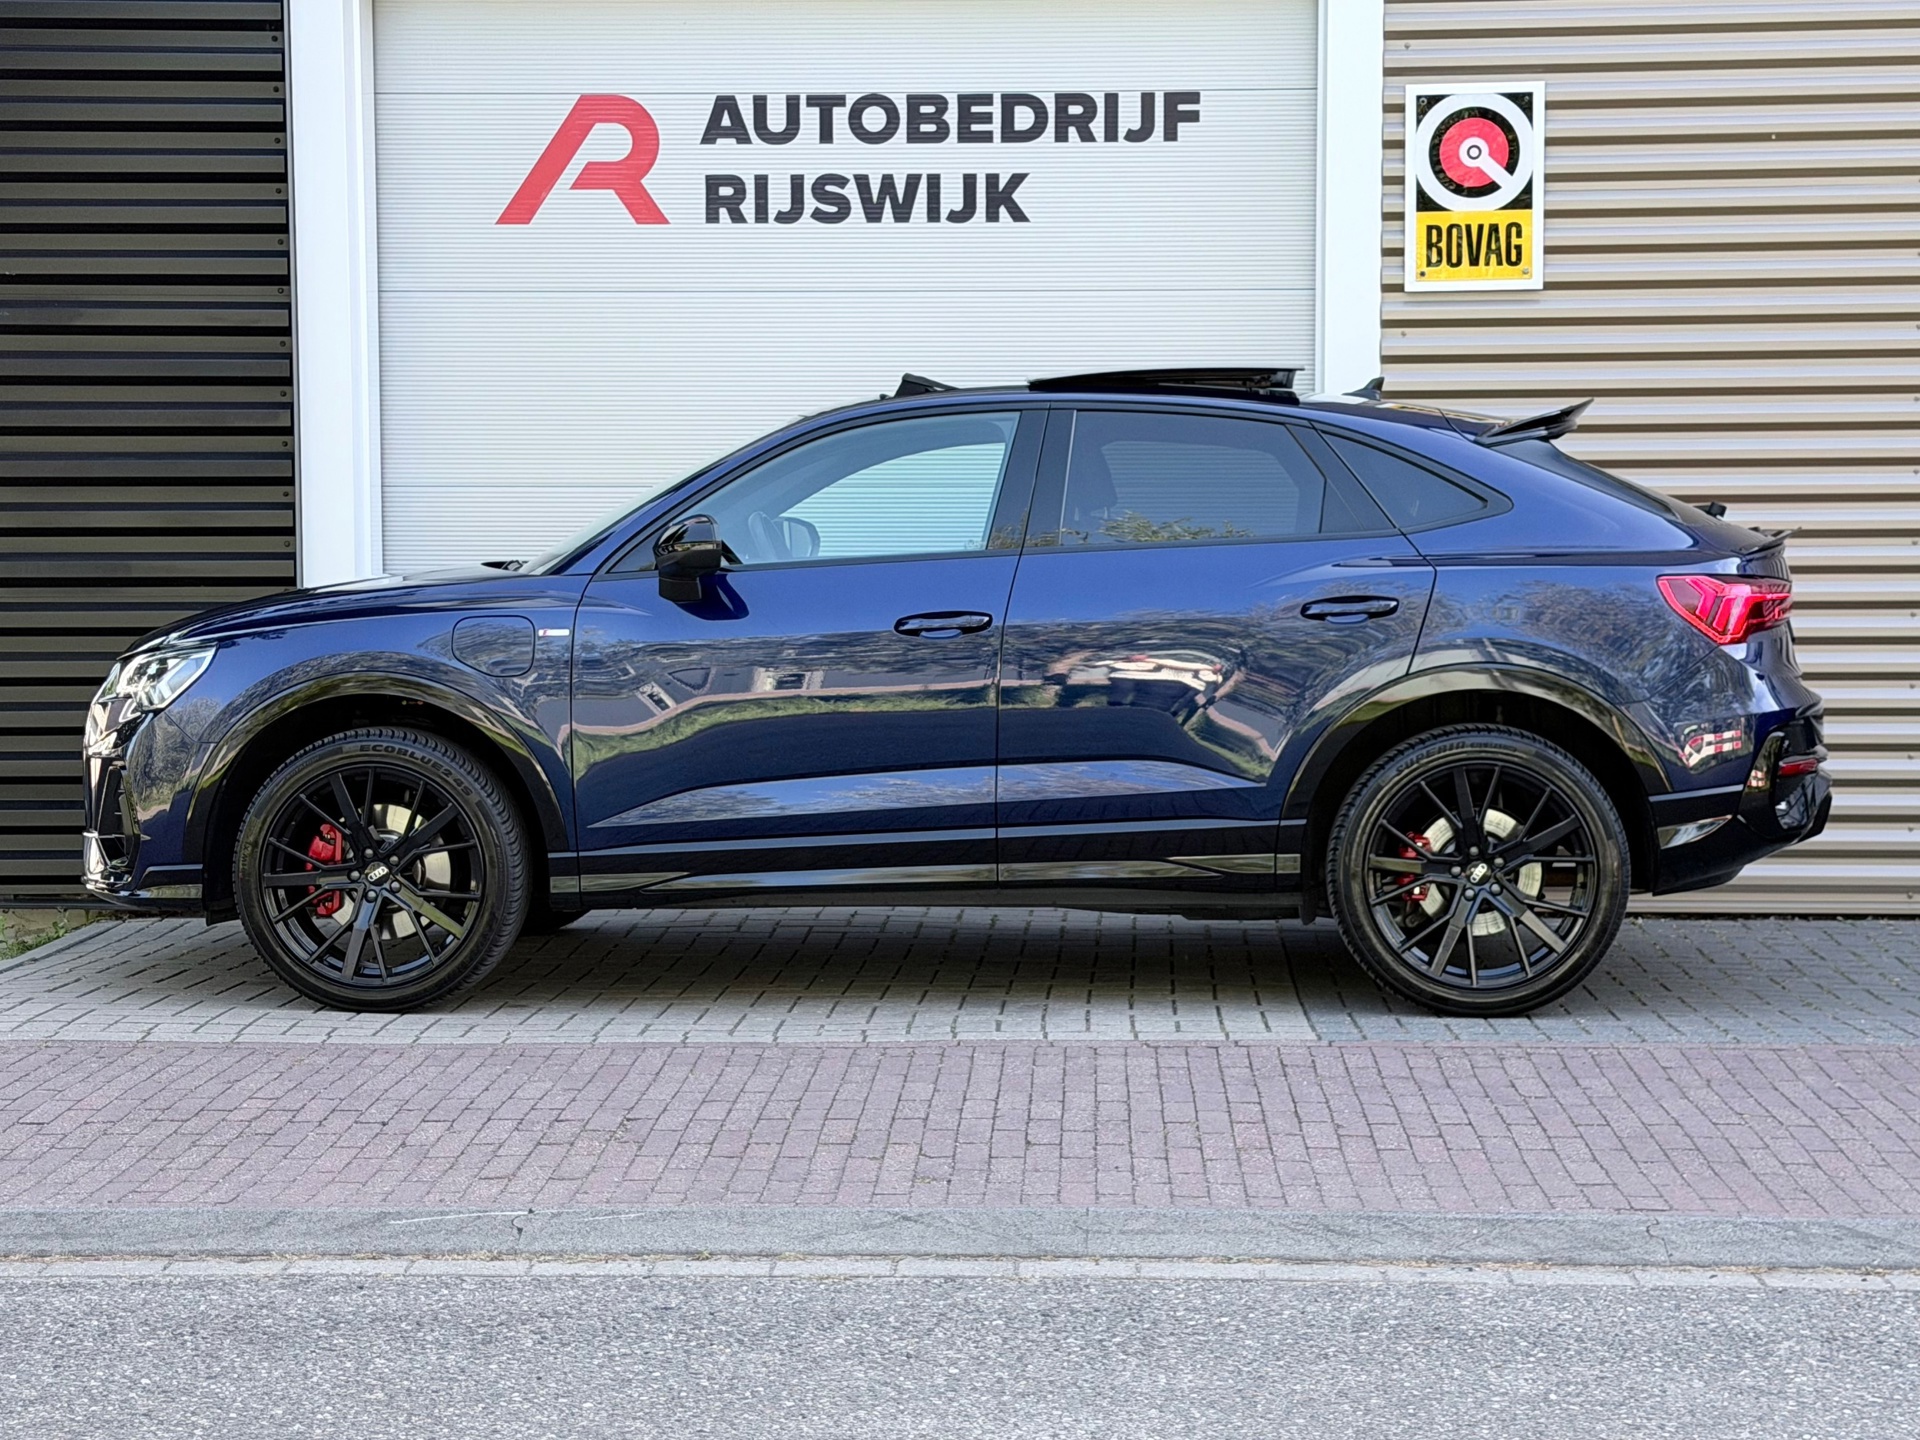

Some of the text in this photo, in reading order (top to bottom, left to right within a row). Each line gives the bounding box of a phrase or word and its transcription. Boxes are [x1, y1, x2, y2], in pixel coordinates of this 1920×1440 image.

[700, 91, 1201, 145] AUTOBEDRIJF
[705, 172, 1031, 225] RIJSWIJK
[1425, 221, 1523, 269] BOVAG
